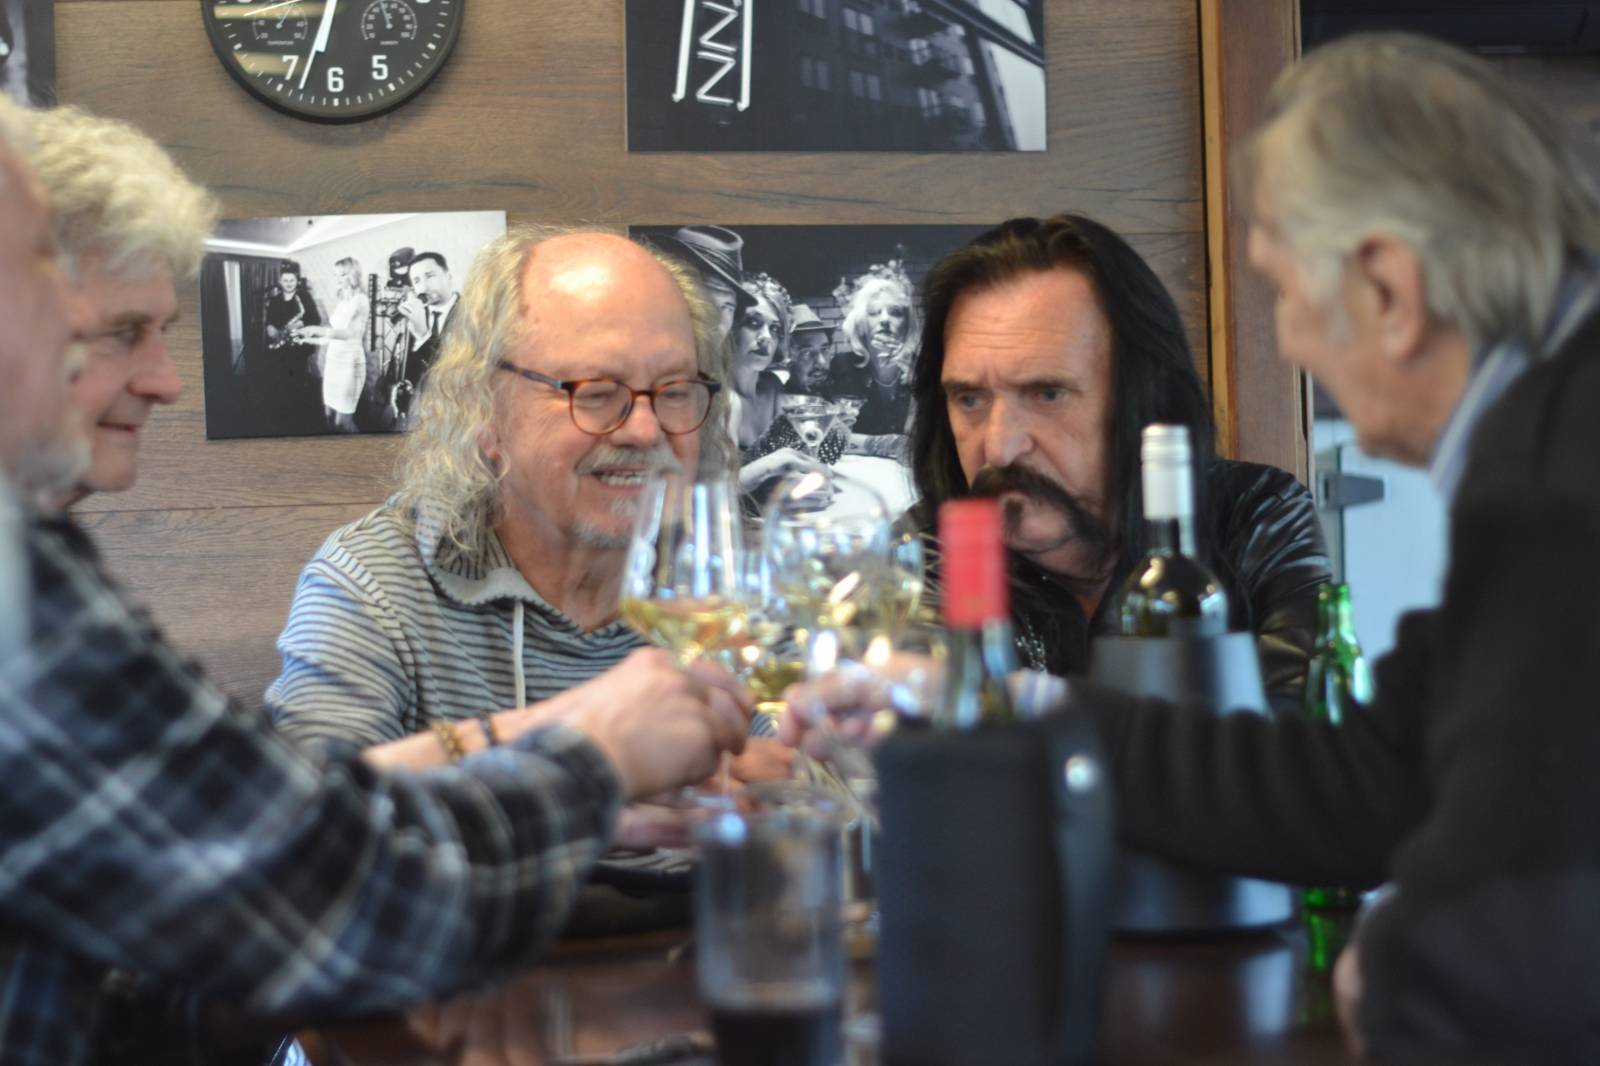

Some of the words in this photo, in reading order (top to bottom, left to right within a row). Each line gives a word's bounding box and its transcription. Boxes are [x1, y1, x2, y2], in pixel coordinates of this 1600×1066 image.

[696, 0, 742, 106] ZZ
[282, 55, 299, 80] 7
[327, 67, 344, 92] 6
[371, 55, 389, 80] 5
